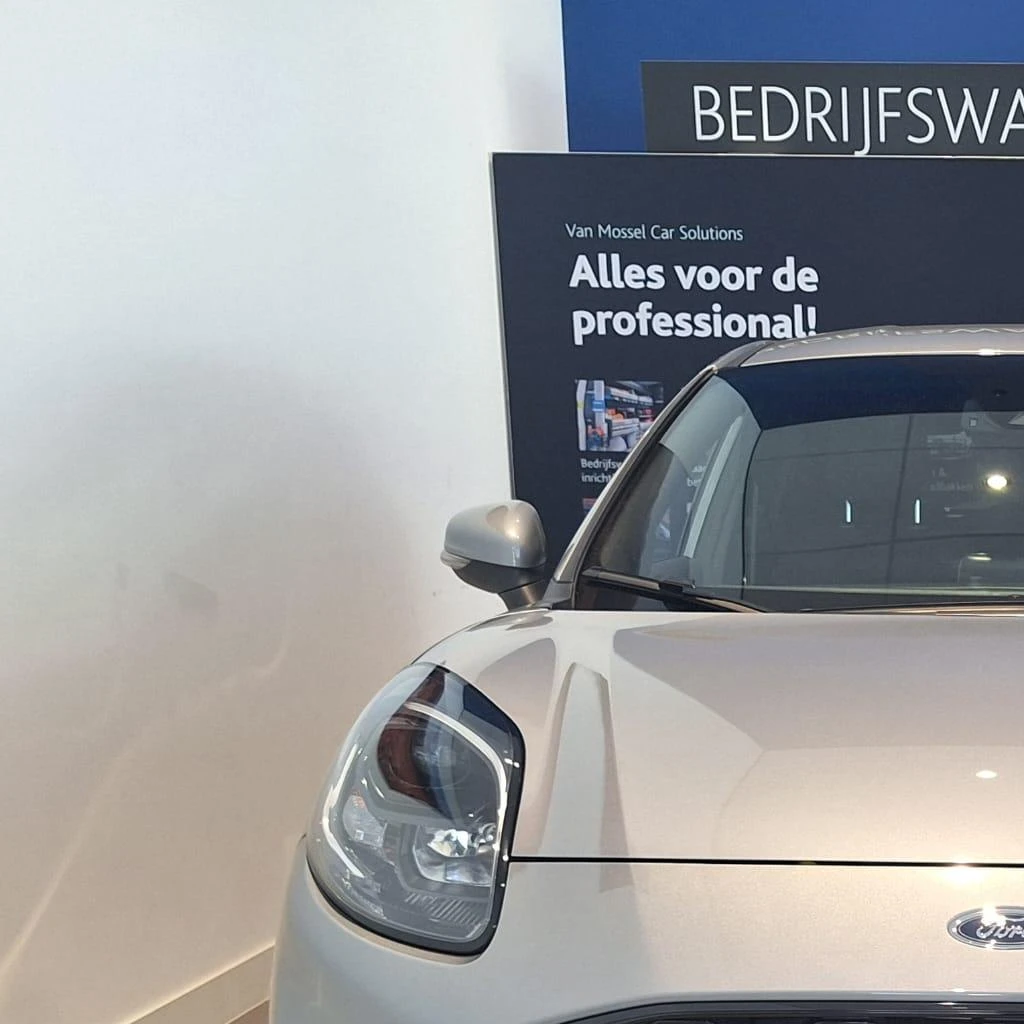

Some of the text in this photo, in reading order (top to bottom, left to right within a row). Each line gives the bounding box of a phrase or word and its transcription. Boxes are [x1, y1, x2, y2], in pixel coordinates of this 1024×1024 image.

[565, 224, 743, 241] Van Mossel Car Solutions
[569, 253, 819, 292] Alles voor de
[572, 301, 817, 345] professional!
